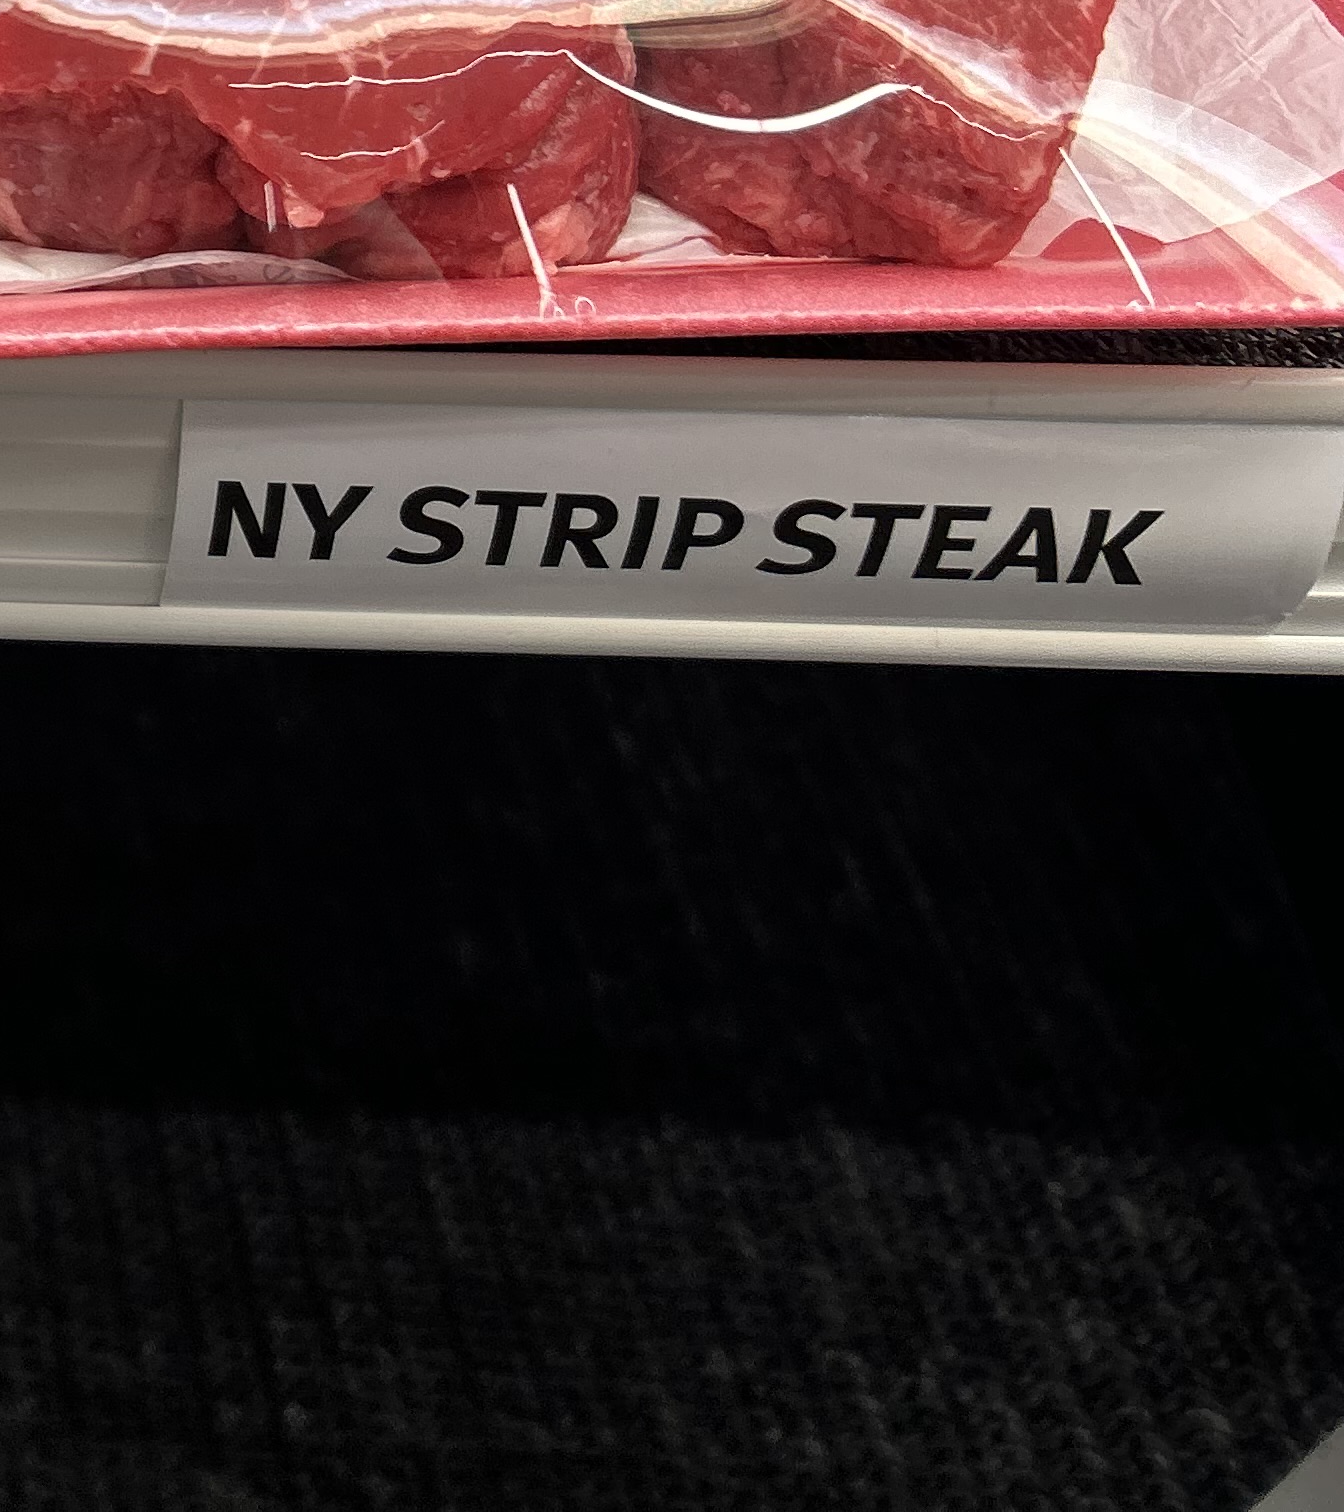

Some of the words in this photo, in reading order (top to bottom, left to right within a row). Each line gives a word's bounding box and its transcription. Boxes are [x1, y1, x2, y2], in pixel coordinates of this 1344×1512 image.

[204, 479, 376, 562] NY
[385, 484, 747, 572] STRIP
[753, 497, 1169, 588] STEAK
